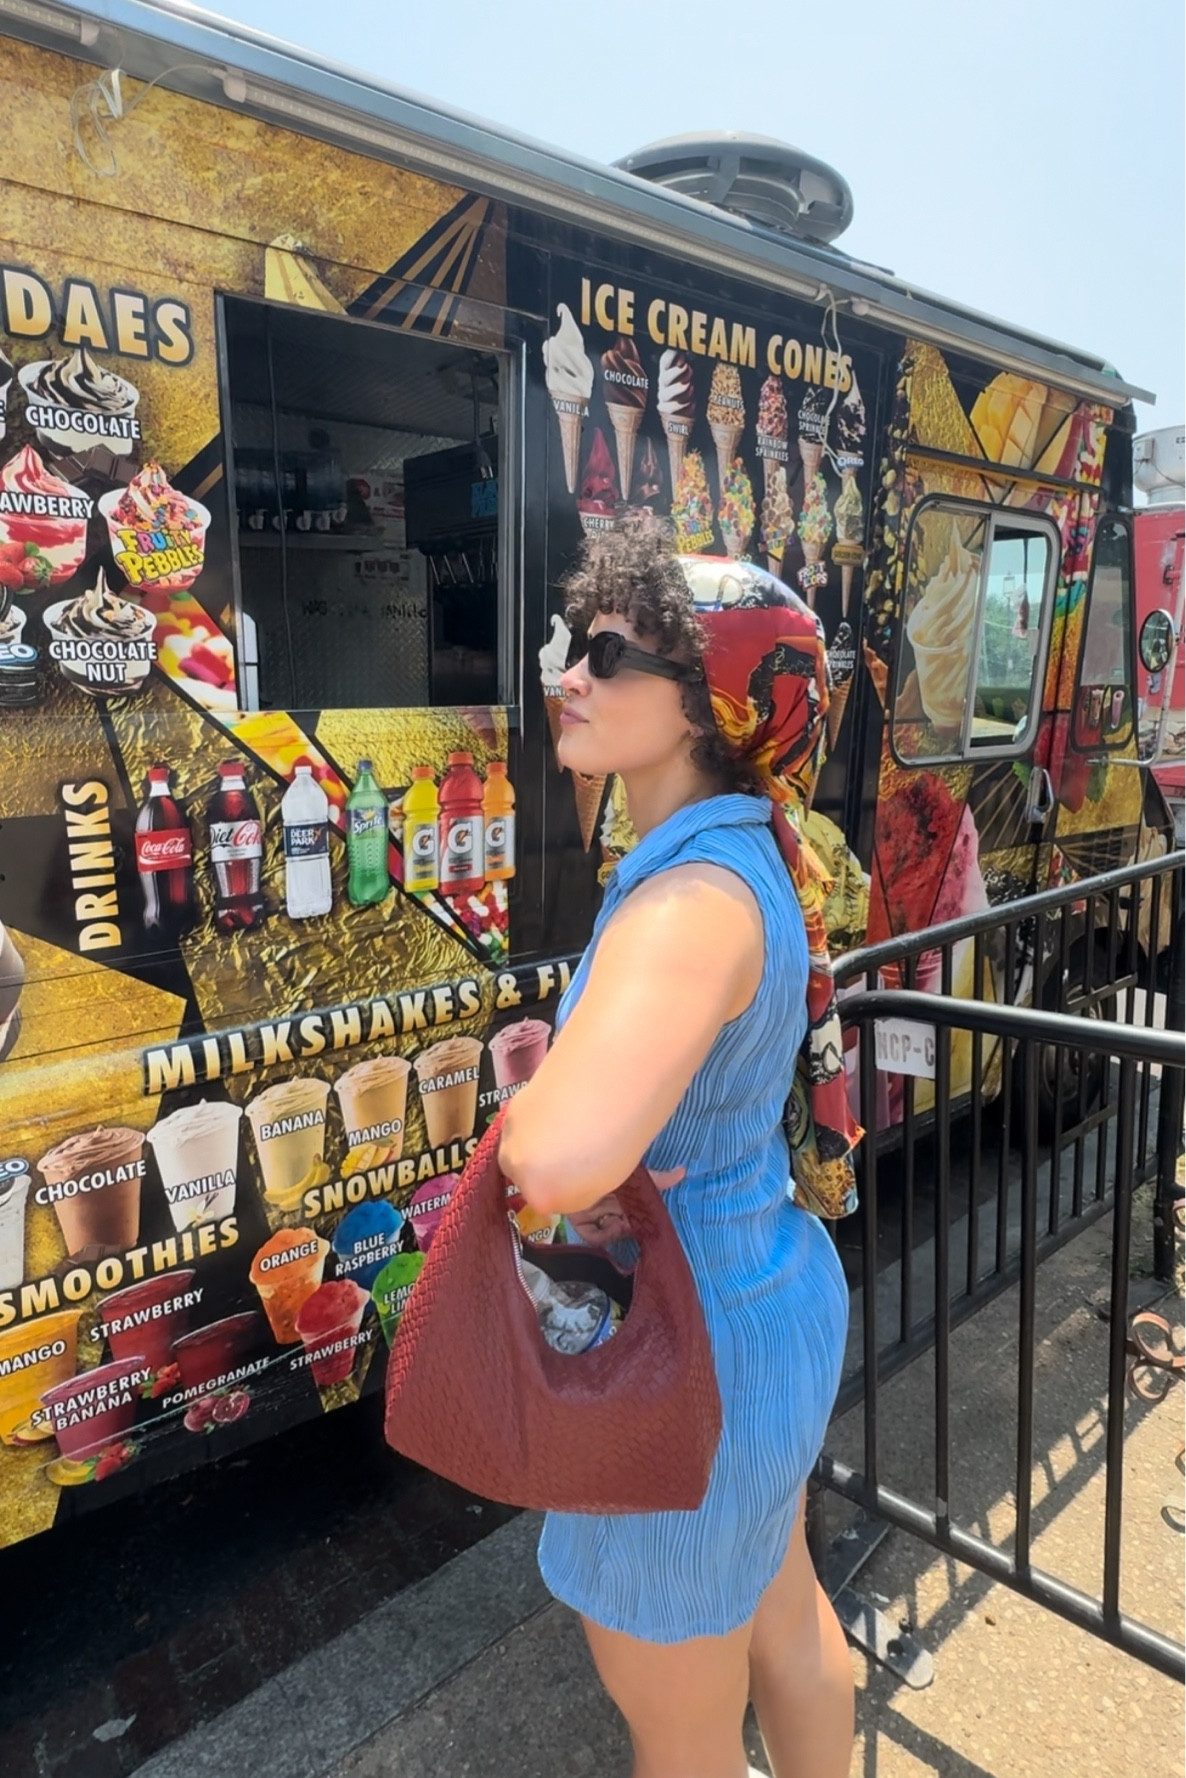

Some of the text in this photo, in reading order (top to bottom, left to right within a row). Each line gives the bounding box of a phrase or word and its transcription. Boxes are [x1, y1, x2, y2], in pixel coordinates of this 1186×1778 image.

[1, 268, 192, 364] DAES
[581, 277, 854, 393] ICE CREAM CONES
[604, 369, 649, 389] CHOCOLATE
[25, 405, 141, 439] CHOCOLATE
[553, 399, 590, 418] VANILA
[798, 409, 830, 425] CHOCOL
[668, 421, 689, 436] SWIRL
[757, 436, 788, 451] RAINBOW
[755, 447, 789, 463] SPRINKLES
[583, 517, 615, 530] CHERRY
[115, 545, 204, 586] PEBBLES
[49, 640, 158, 661] CHOCOLATE
[86, 662, 127, 682] NUT
[290, 829, 315, 839] DEER
[353, 815, 384, 834] Sprite
[447, 822, 473, 854] G
[485, 821, 506, 848] G
[290, 837, 315, 846] PARK
[412, 828, 435, 857] G
[62, 780, 122, 952] DRINKS
[145, 978, 482, 1095] MILKSHAKES
[496, 972, 522, 1009] &
[418, 1066, 481, 1095] CARAMEL
[260, 1110, 325, 1142] BANANA
[347, 1119, 402, 1148] MANGO
[35, 1160, 147, 1206] CHOCOLATE
[164, 1170, 236, 1203] VANILLA
[303, 1136, 479, 1219] SNOWBALLS
[259, 1240, 319, 1273] ORANGE
[334, 1240, 404, 1276] RASPBERRY
[353, 1233, 386, 1255] BLUE
[0, 1217, 240, 1327] SMOOTHIES
[90, 1288, 204, 1342] STRAWBERRY
[0, 1339, 67, 1376] MANGO
[289, 1329, 374, 1371] STRAWBERRY
[30, 1366, 151, 1427] STRAWBERRY
[162, 1356, 271, 1409] POMEGRANATE
[56, 1391, 133, 1431] BANANA
